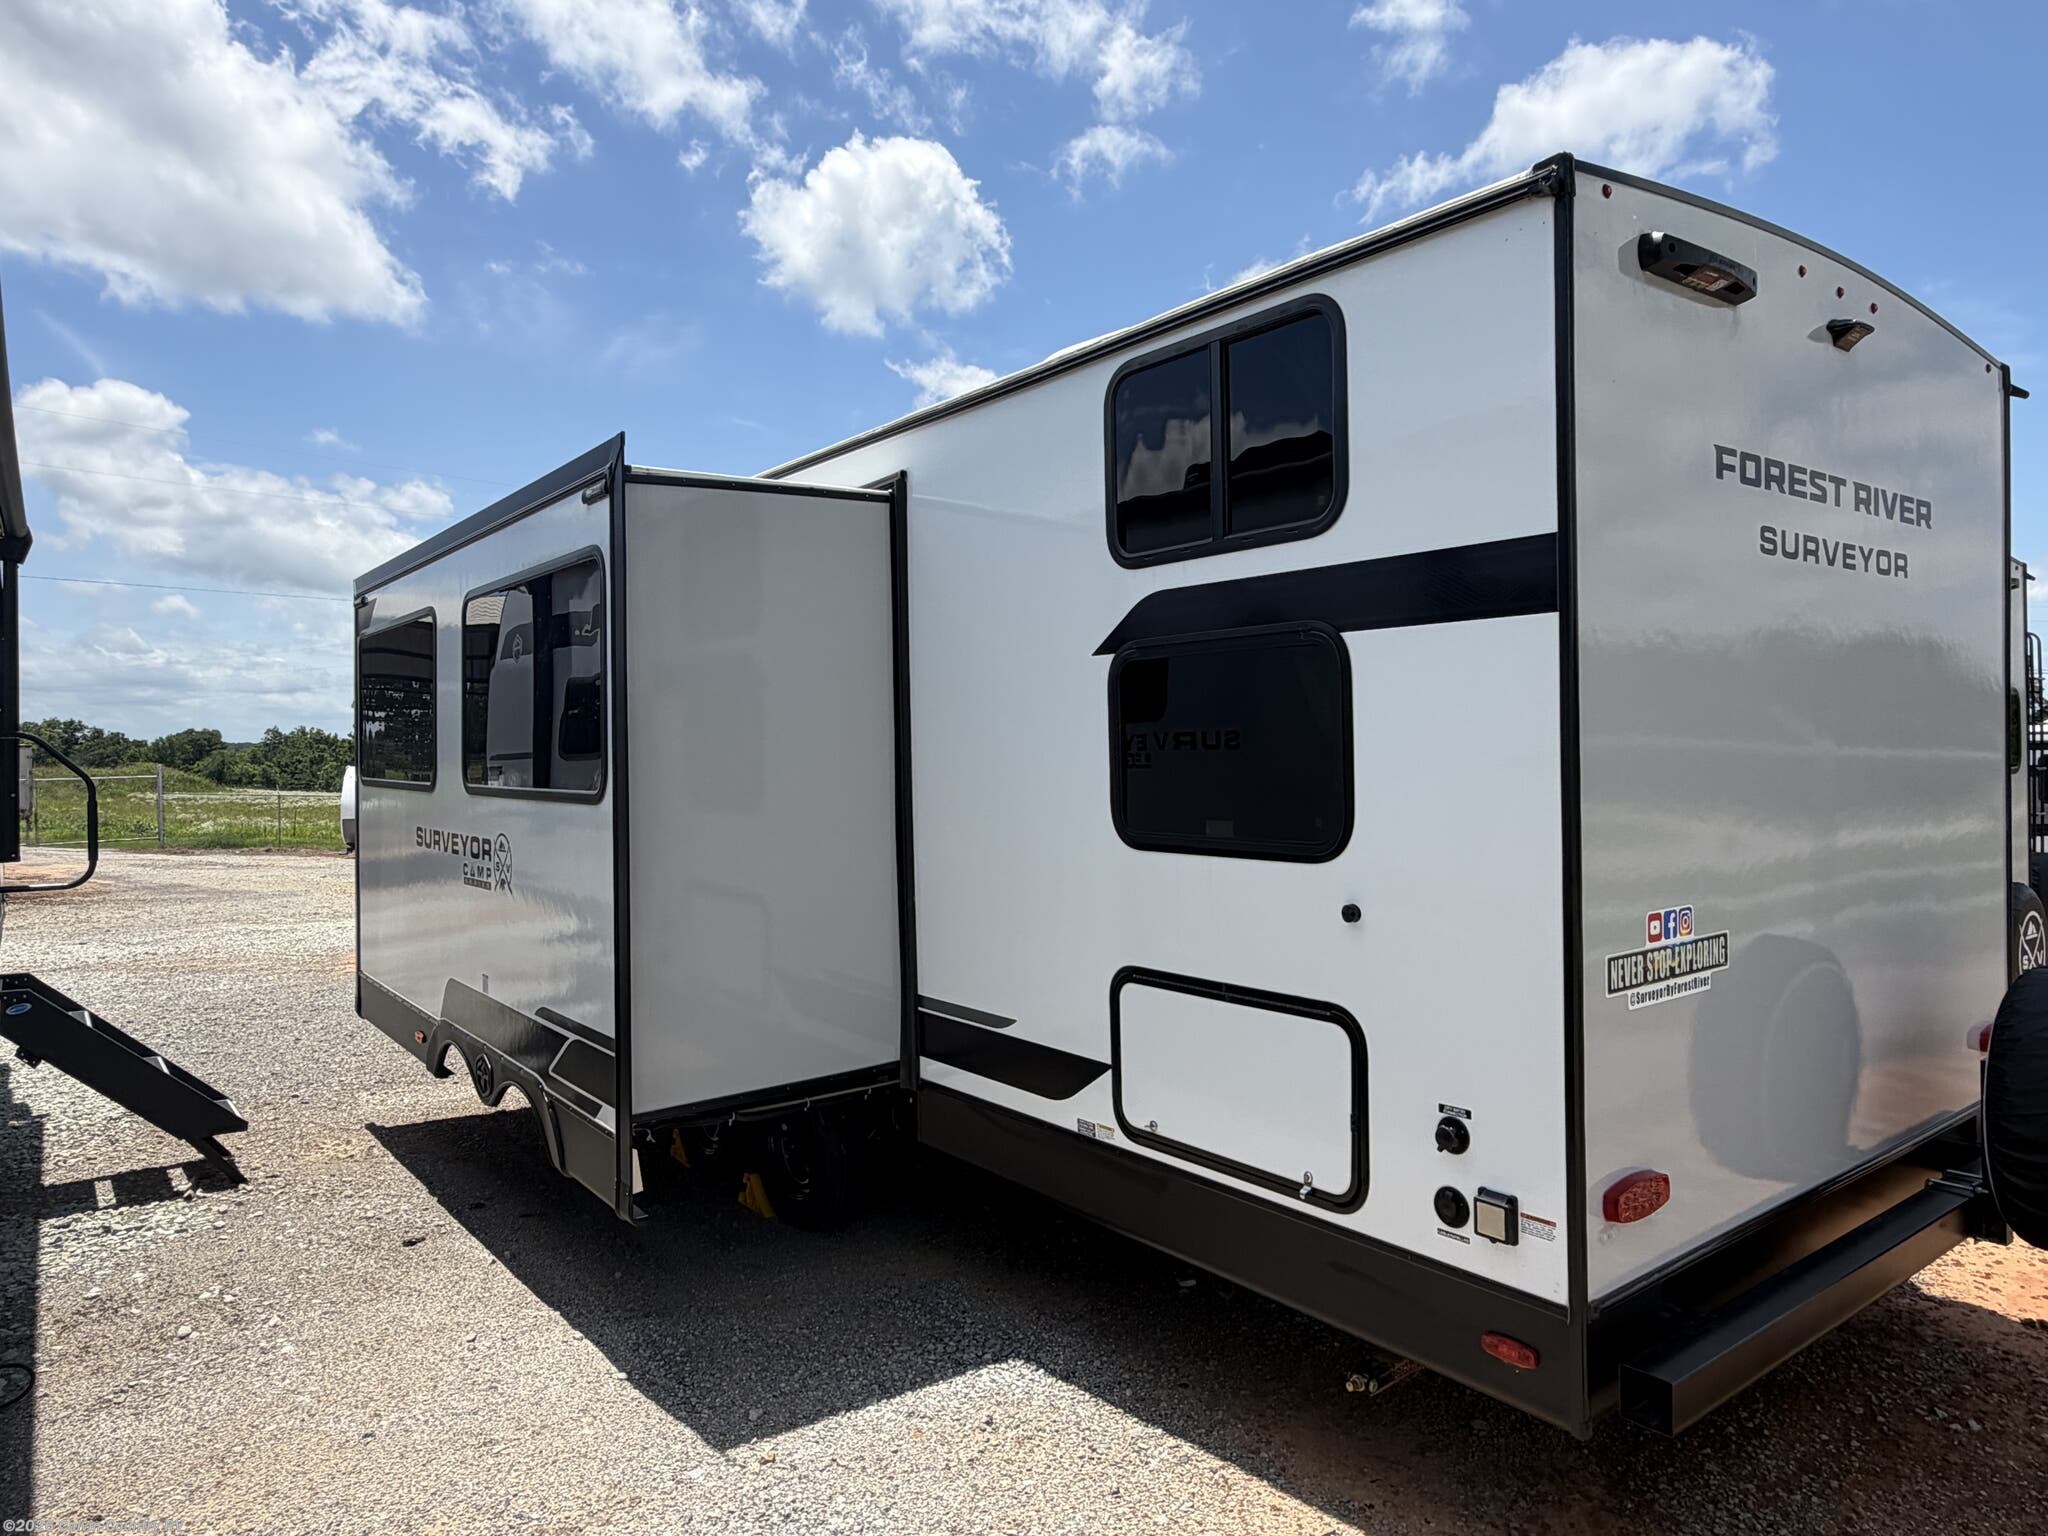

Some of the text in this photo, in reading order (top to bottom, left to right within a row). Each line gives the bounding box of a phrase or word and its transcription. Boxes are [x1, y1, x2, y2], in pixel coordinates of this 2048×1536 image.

[1713, 443, 1933, 530] FOREST RIVER
[1759, 524, 1909, 579] SURVEYOR
[416, 826, 492, 862] SURVEYOR
[462, 862, 492, 881] CAMP
[1610, 935, 1726, 991] NEVER STOP EXPLORING
